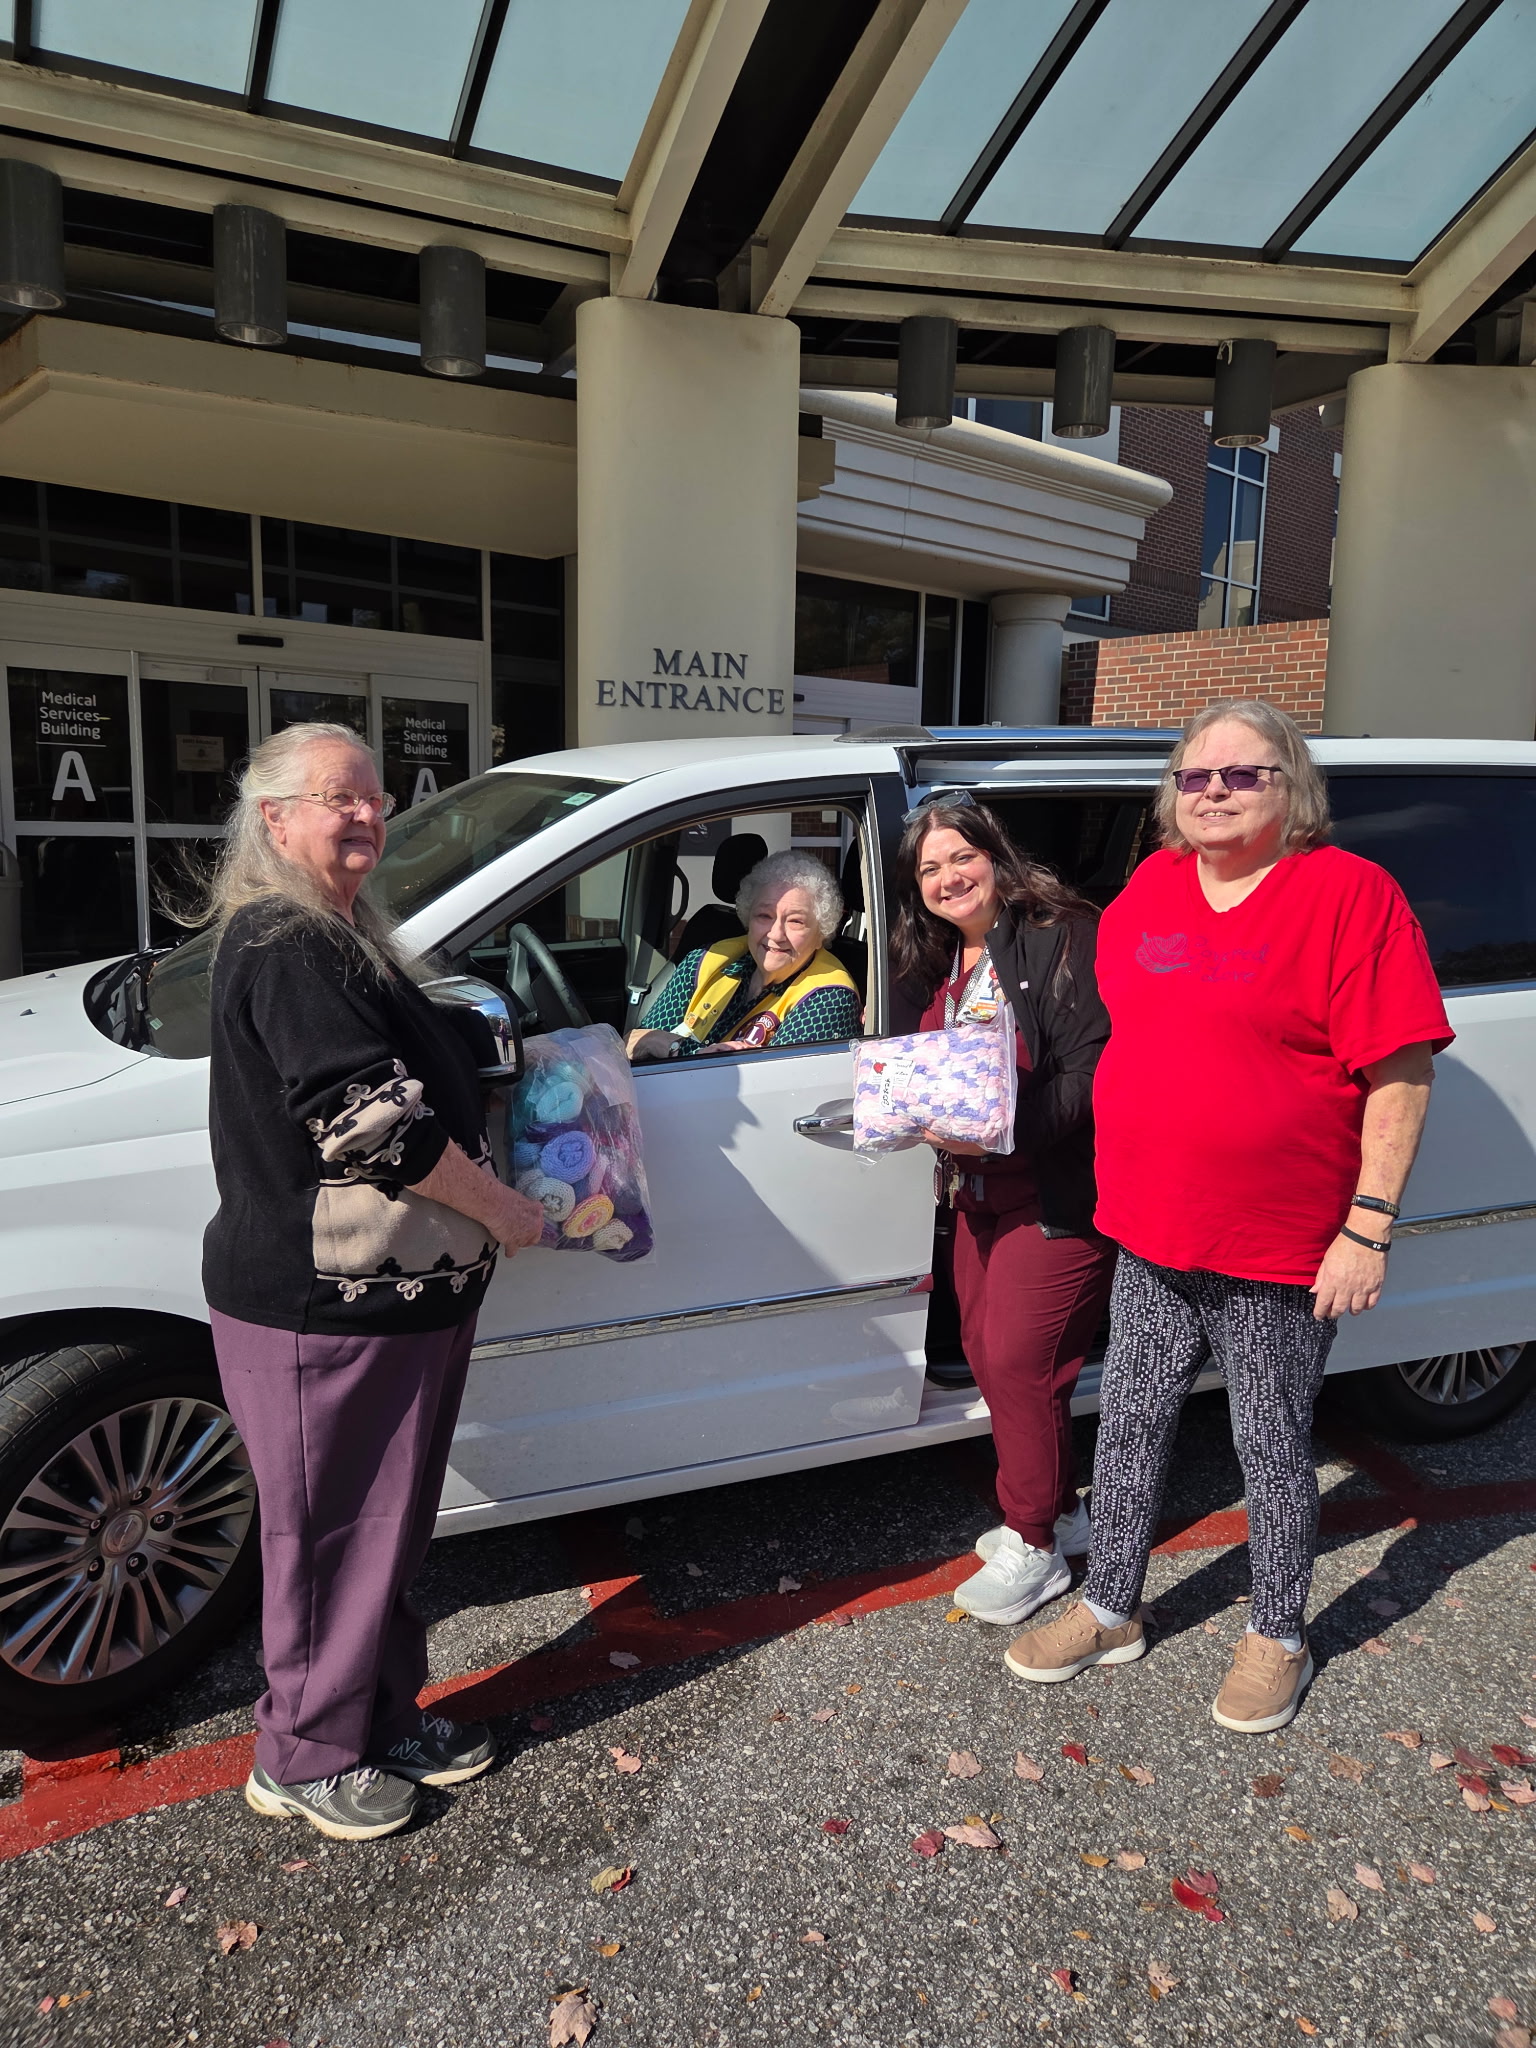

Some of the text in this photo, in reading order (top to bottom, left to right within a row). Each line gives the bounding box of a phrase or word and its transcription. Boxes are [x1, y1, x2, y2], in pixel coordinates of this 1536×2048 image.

[653, 648, 749, 680] MAIN
[41, 690, 97, 707] Medical
[595, 679, 786, 715] ENTRANCE
[39, 706, 101, 722] Services
[405, 716, 446, 730] Medical
[40, 721, 101, 740] Building
[403, 730, 448, 743] Services
[404, 743, 448, 759] Building
[51, 750, 97, 802] A
[411, 767, 440, 808] A
[1187, 935, 1270, 964] Covered
[745, 1025, 760, 1046] L
[503, 1304, 761, 1351] CHRYSLER
